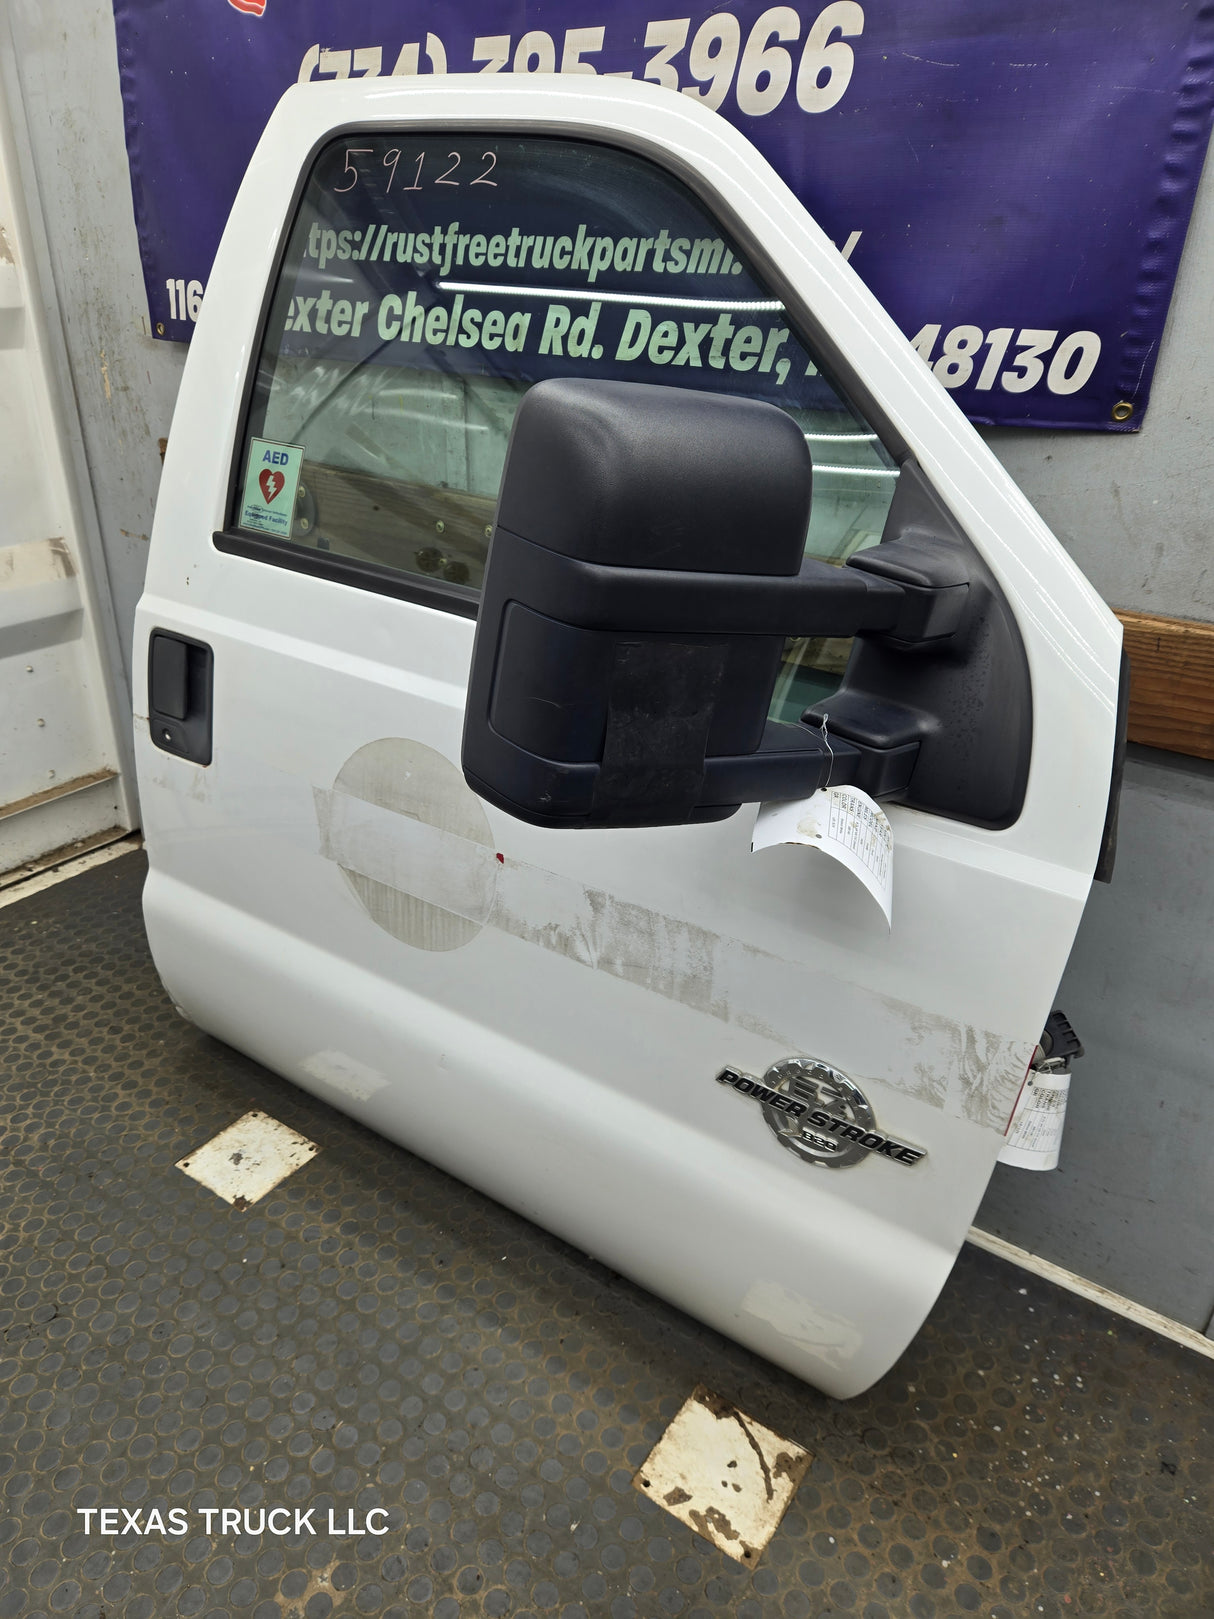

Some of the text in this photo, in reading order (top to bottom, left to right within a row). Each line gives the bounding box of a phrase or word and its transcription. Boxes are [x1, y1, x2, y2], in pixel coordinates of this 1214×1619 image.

[334, 148, 498, 193] 59122
[378, 293, 532, 353] Chelsea
[538, 302, 604, 359] Rd.
[615, 308, 791, 385] Dexter,
[262, 449, 289, 466] AED
[715, 1064, 927, 1166] POWER STROKE
